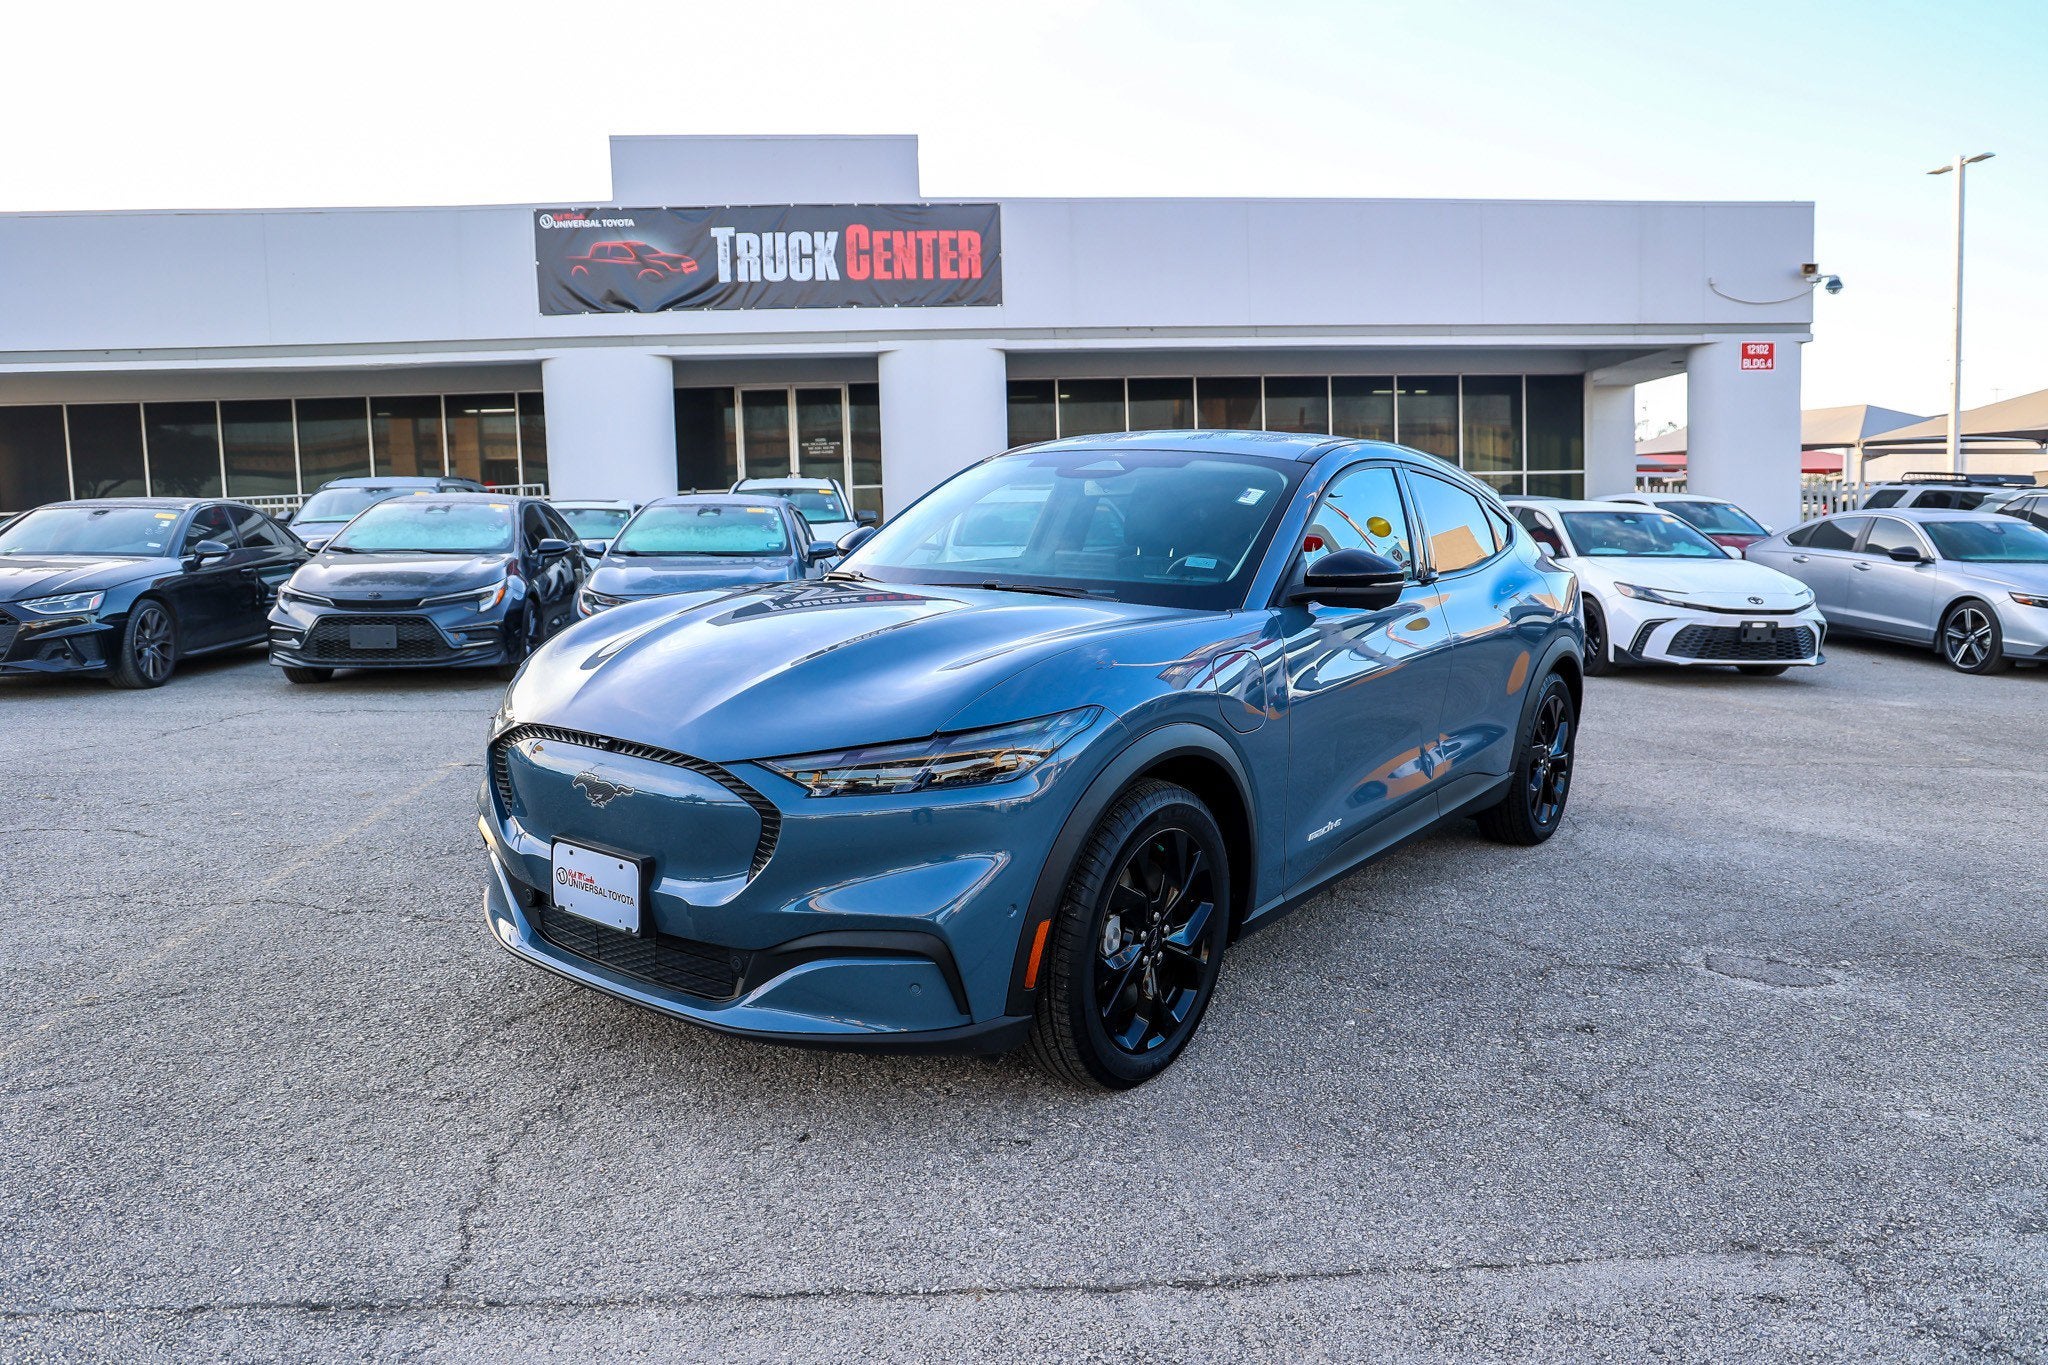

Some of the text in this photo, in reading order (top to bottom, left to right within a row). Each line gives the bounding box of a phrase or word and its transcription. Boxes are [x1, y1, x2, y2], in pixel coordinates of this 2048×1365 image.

[553, 218, 635, 228] UNIVERSAL TOYOTA
[710, 224, 982, 284] TRUCK CENTER
[568, 879, 635, 907] UNIVERSAL TOYOTA
